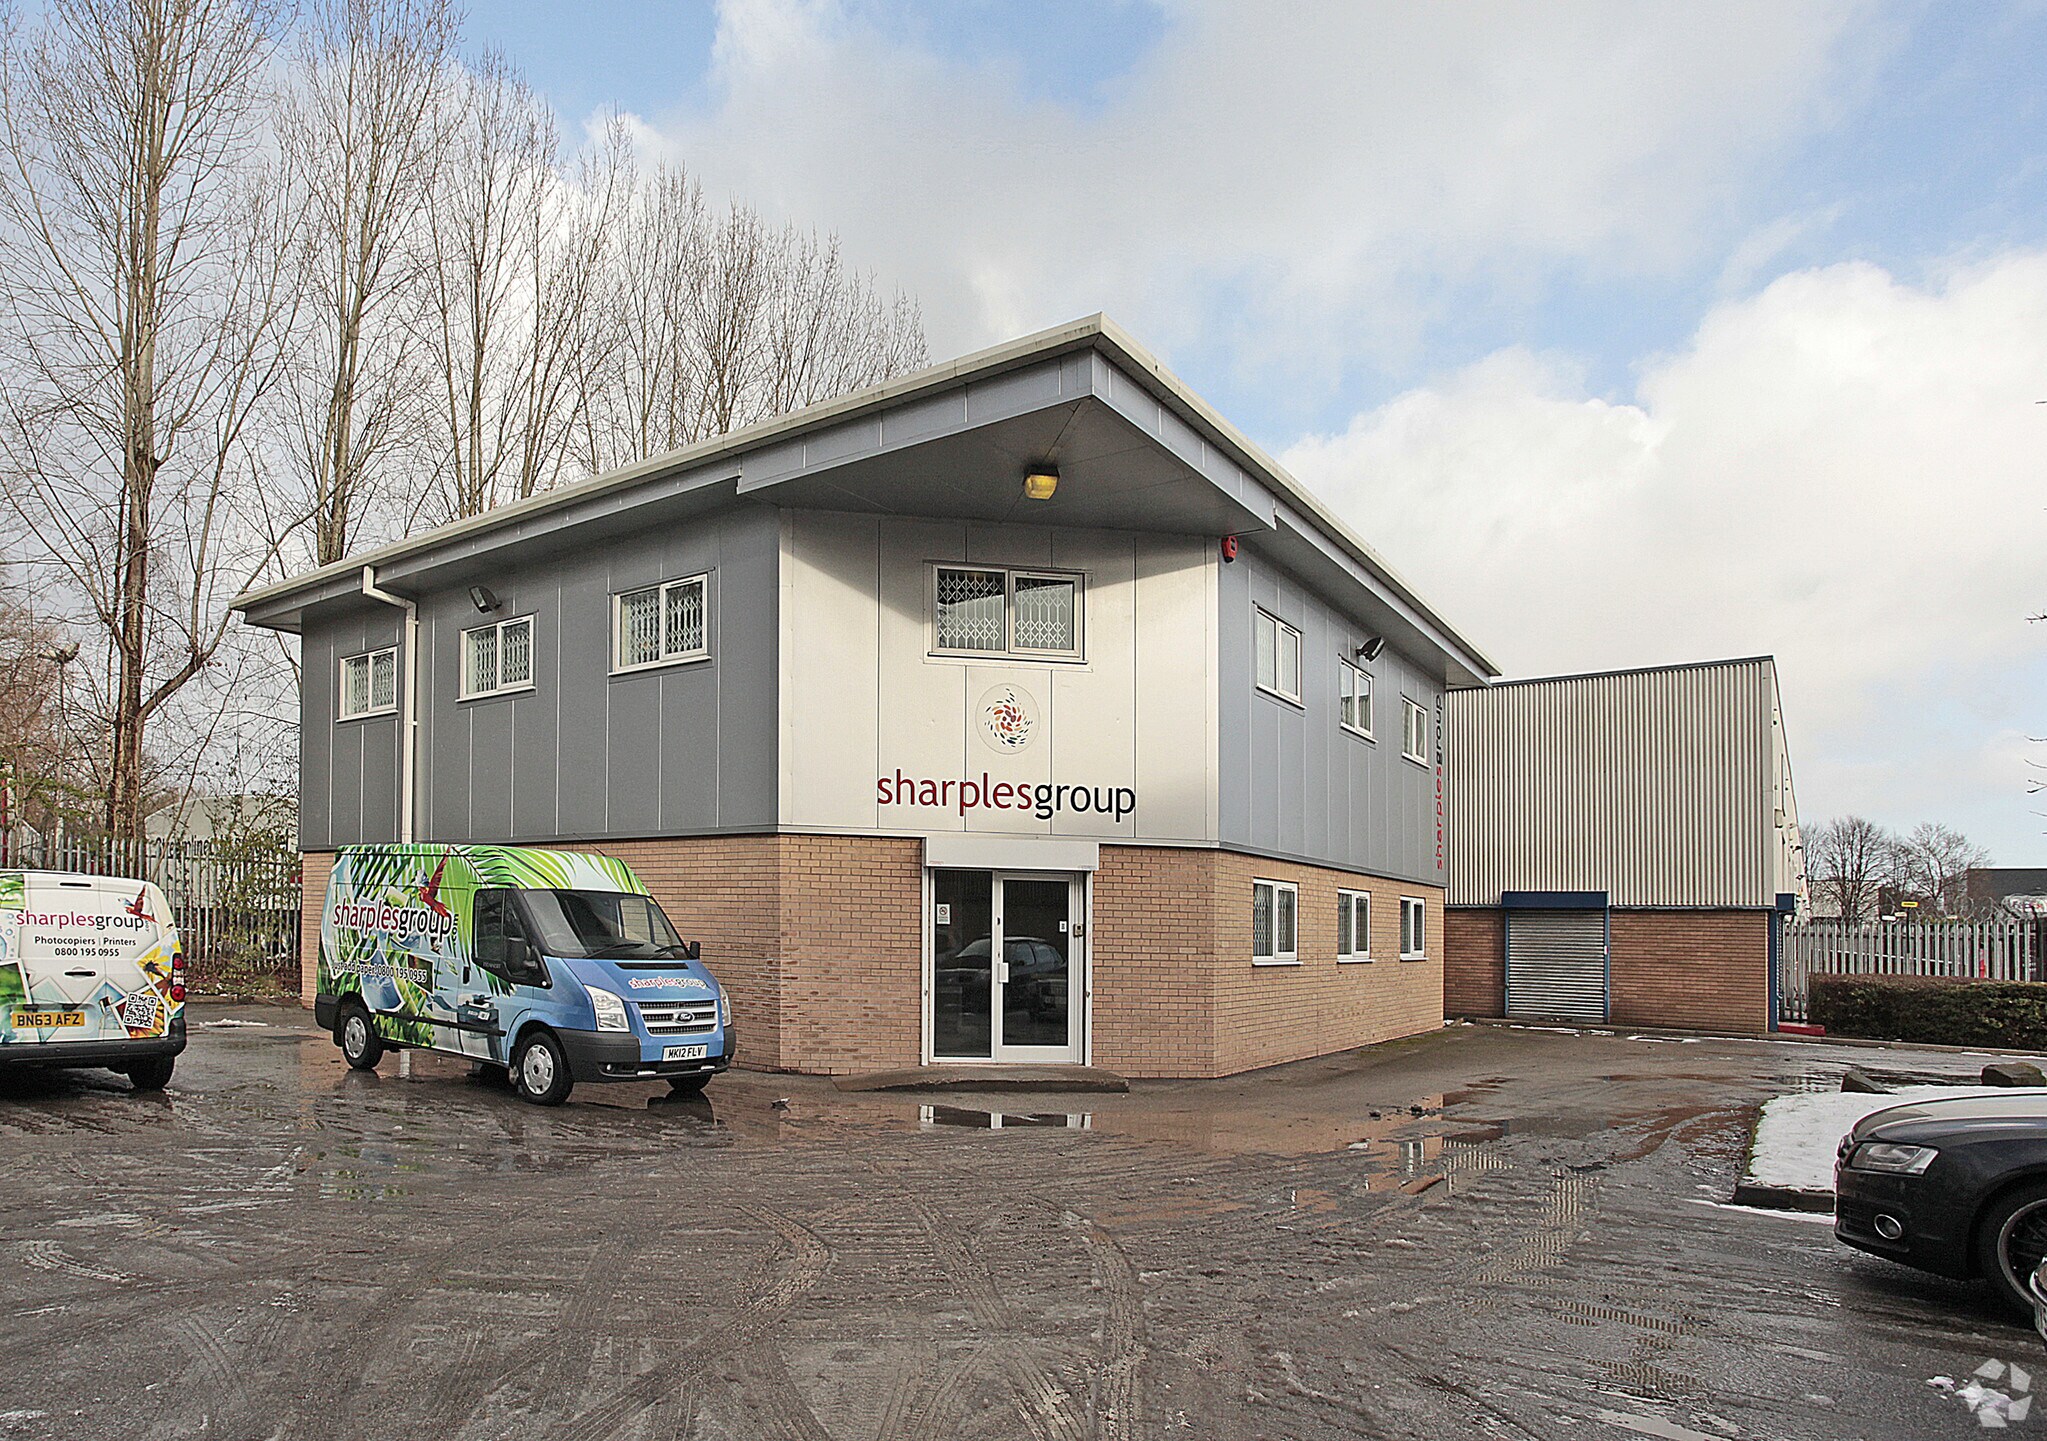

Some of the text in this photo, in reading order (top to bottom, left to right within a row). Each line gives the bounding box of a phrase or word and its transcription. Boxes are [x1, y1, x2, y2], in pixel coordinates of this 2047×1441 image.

[1435, 694, 1443, 870] sharplesgroup
[877, 769, 1136, 823] sharplesgroup
[16, 910, 144, 931] sharplesgroup
[333, 898, 452, 942] sharplesgroup
[34, 936, 137, 946] Photocopiers Printers
[54, 947, 120, 957] 0800 195 0955
[377, 965, 394, 977] 0800
[395, 967, 408, 979] 195
[408, 969, 427, 982] 0955
[628, 976, 706, 989] sharplesgroup
[17, 1013, 80, 1026] BN63 AFZ
[668, 1047, 687, 1059] MK12
